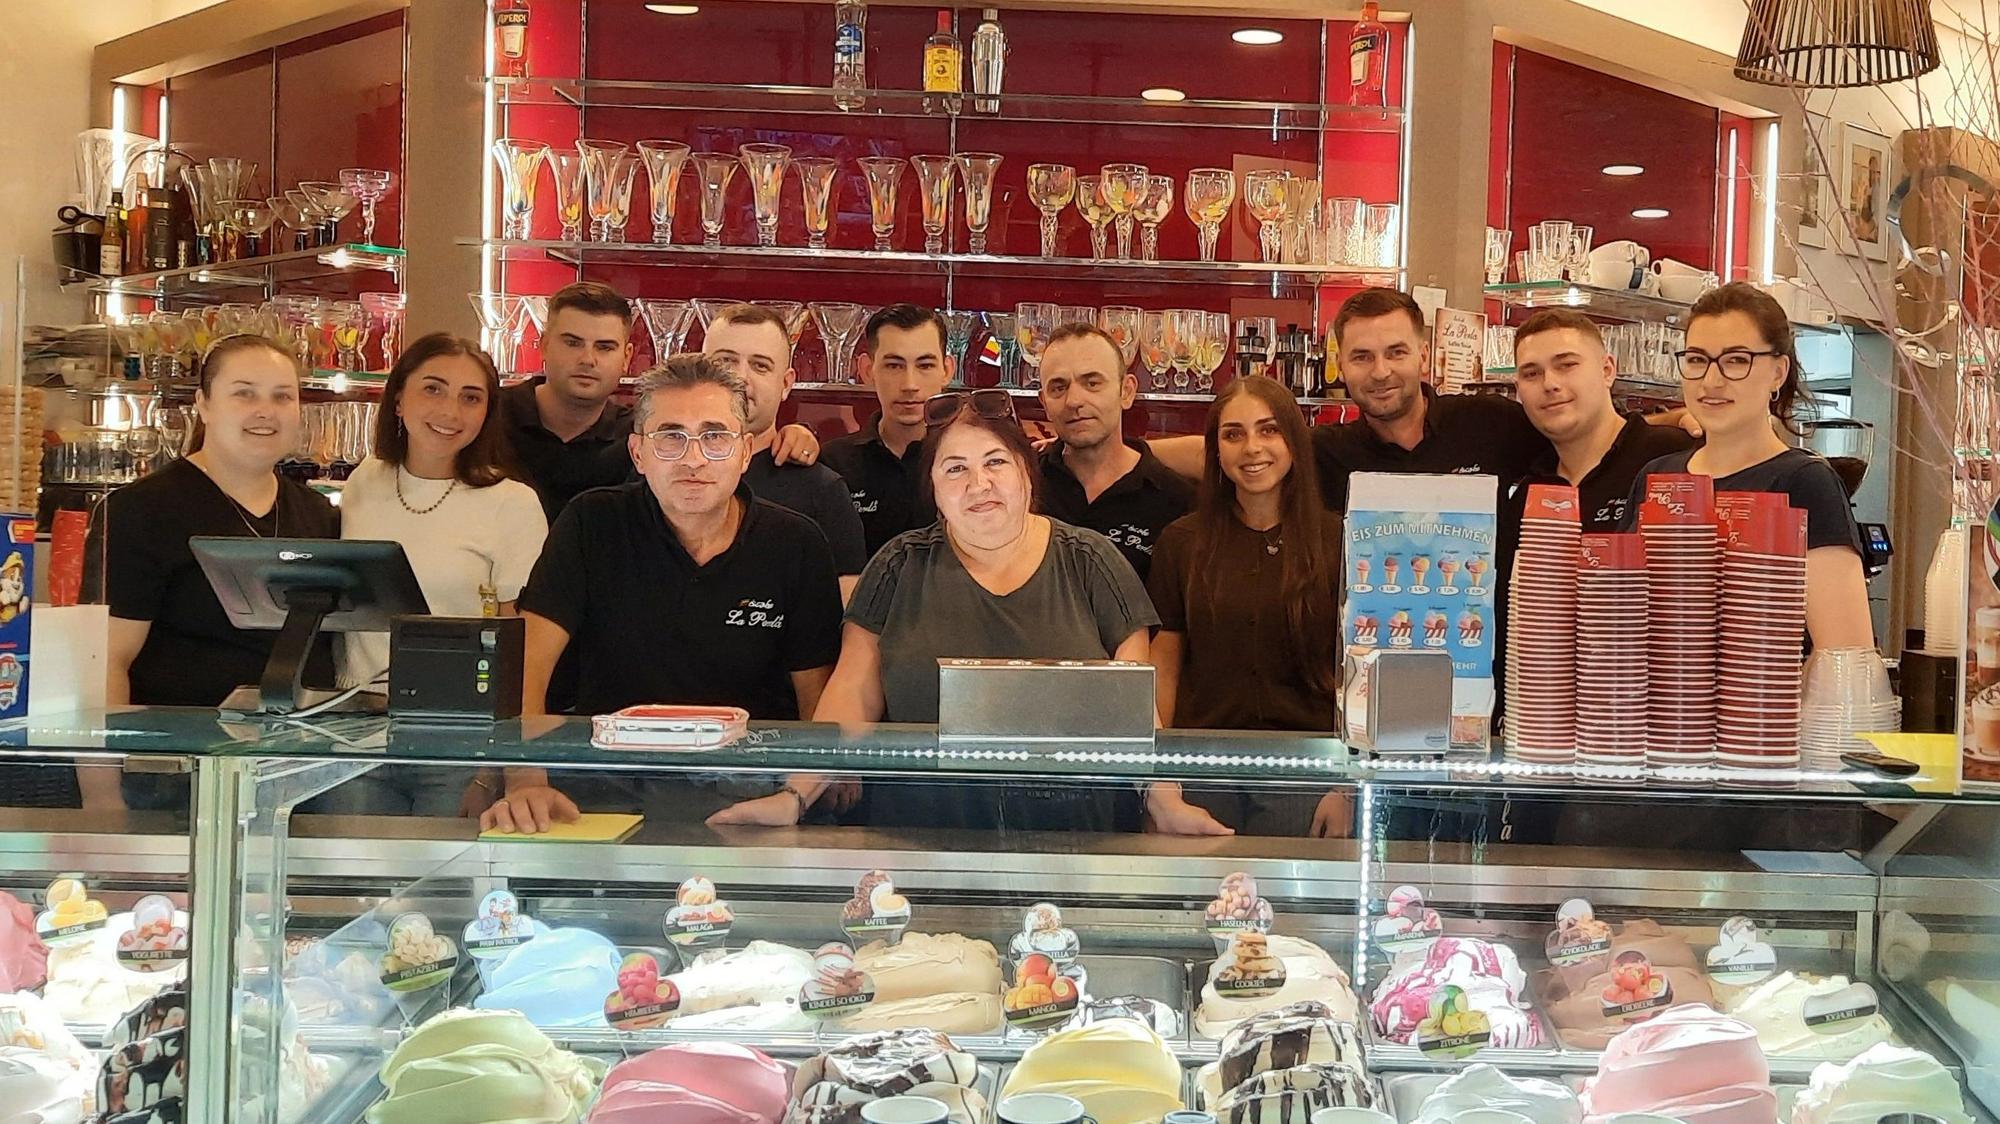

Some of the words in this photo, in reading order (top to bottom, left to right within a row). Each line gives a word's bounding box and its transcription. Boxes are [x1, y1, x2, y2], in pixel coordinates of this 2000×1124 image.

[1351, 527, 1372, 542] EIS
[1374, 523, 1405, 537] ZUM
[1408, 522, 1492, 545] MITNEHMEN
[864, 917, 888, 926] KAFFEE
[1220, 920, 1257, 928] HASELNUSS
[686, 923, 714, 932] MALAGA
[1560, 943, 1601, 955] SCHOKOLADE
[1727, 964, 1754, 972] VANILLE
[1234, 979, 1265, 988] COOKIES
[808, 997, 836, 1009] KINDER
[837, 994, 867, 1006] SCHOKO
[1028, 1003, 1057, 1016] MANGO
[1439, 1036, 1471, 1048] ZITRONE
